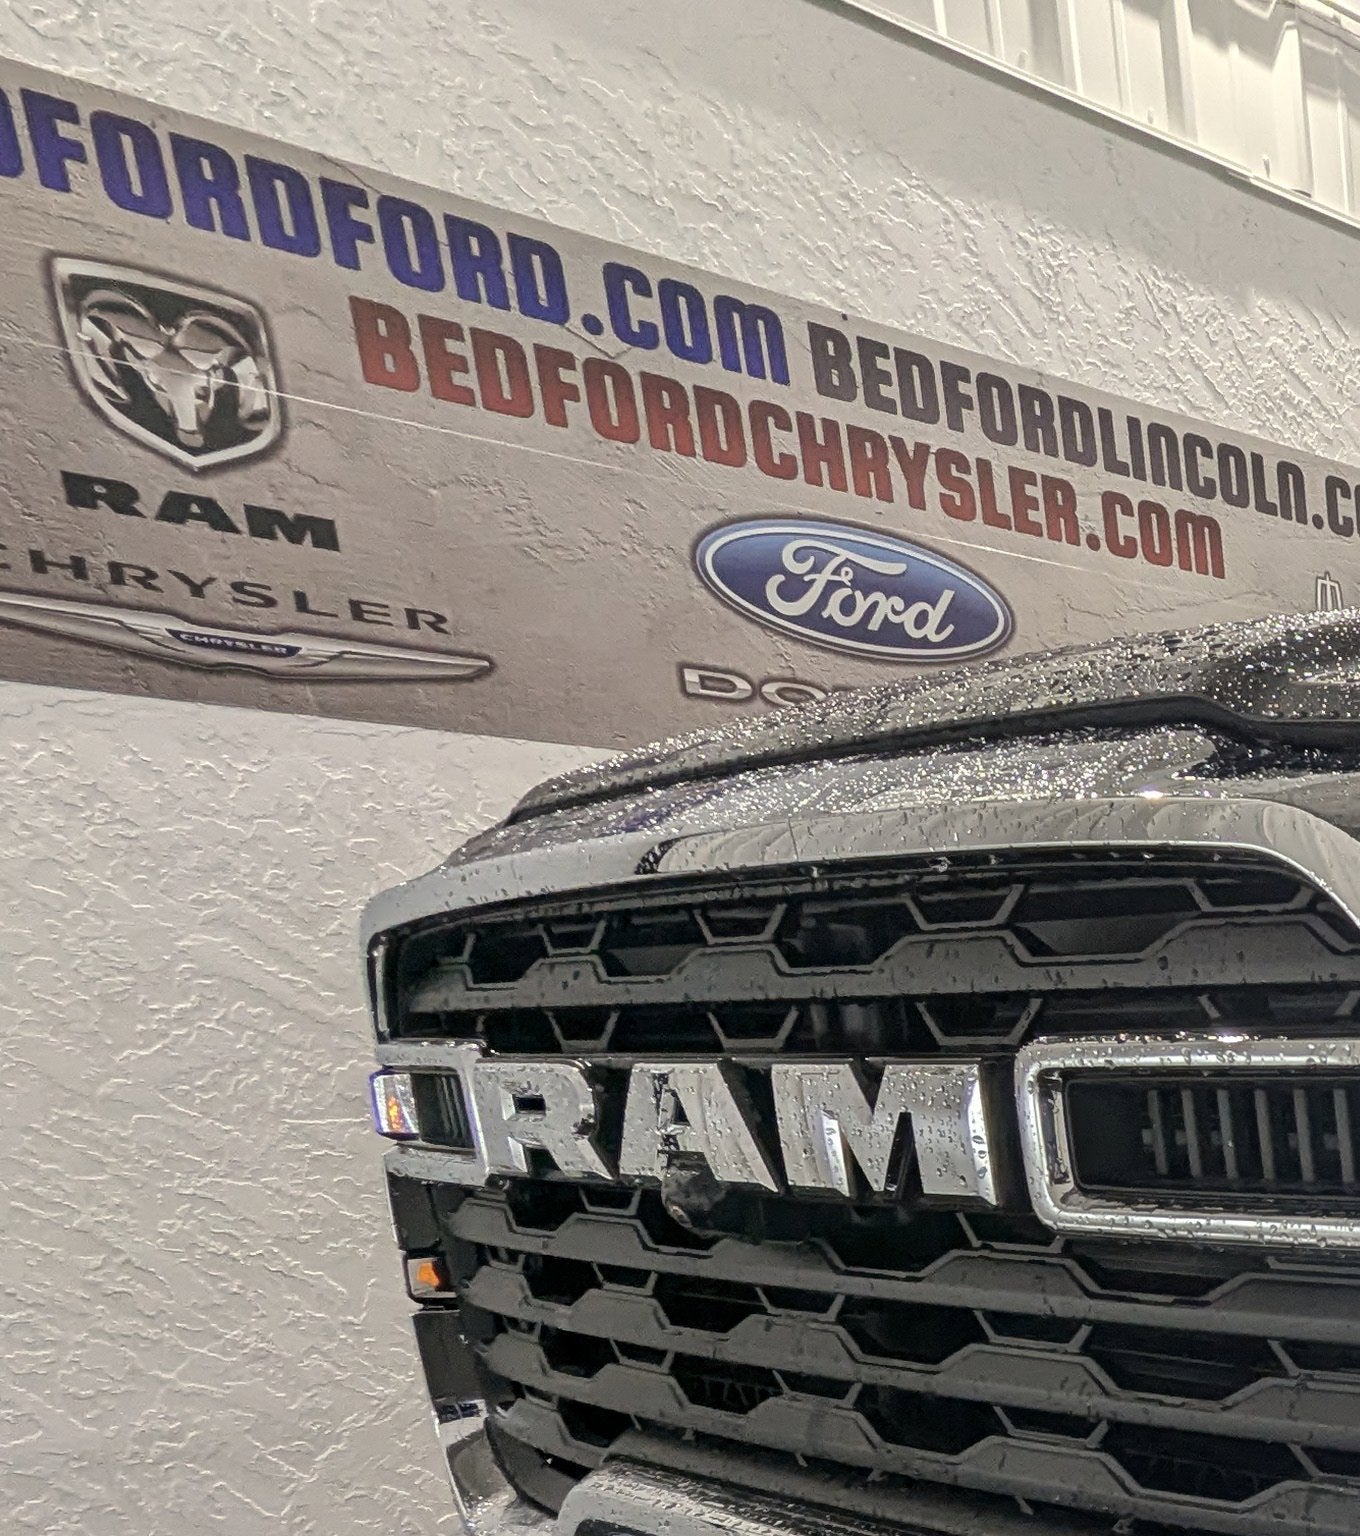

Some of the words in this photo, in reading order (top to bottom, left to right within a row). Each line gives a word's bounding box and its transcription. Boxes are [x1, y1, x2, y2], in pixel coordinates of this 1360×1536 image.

[348, 296, 1225, 579] BEDFORDCHRYSLER.COM
[60, 470, 341, 552] RAM
[766, 538, 955, 643] Ford
[474, 1058, 998, 1205] RAM
